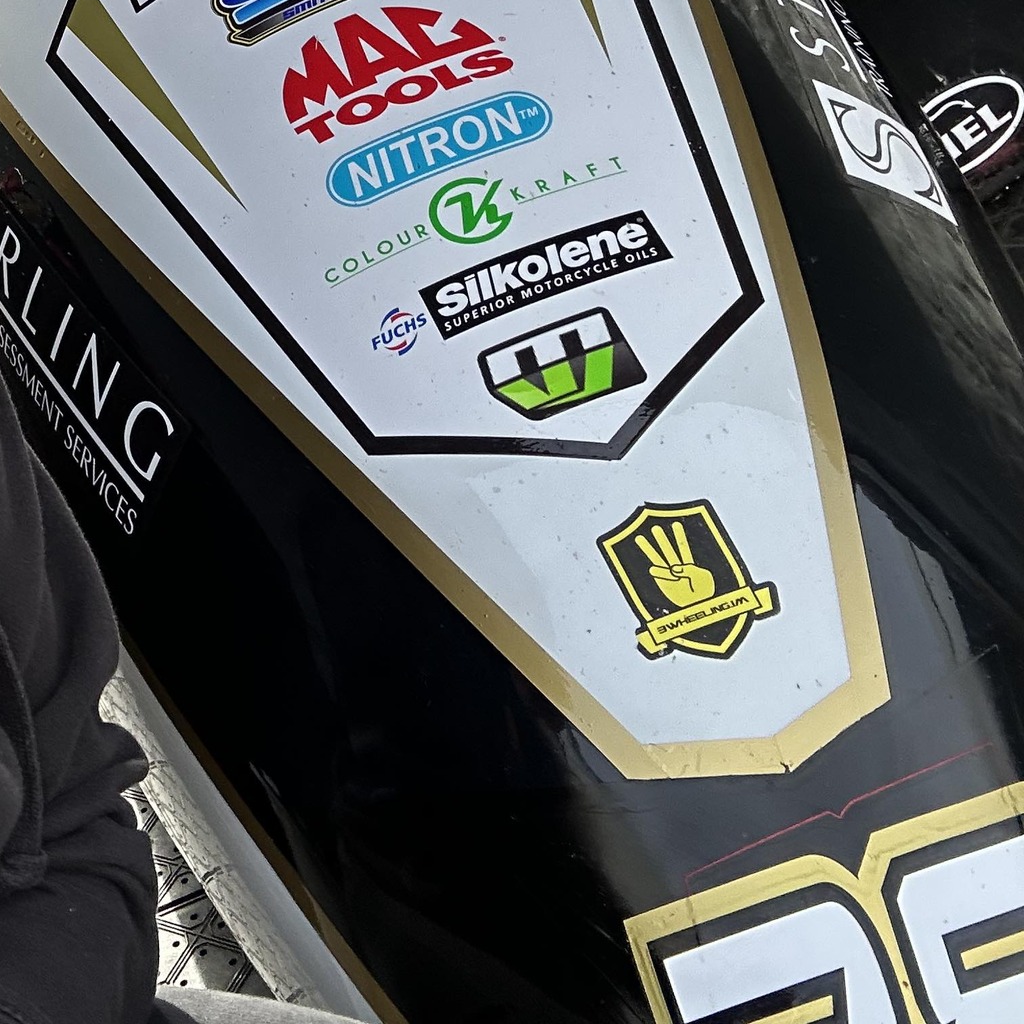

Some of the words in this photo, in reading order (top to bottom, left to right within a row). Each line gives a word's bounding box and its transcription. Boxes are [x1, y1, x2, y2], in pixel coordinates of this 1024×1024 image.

[282, 6, 496, 125] MAC
[293, 49, 514, 144] TOOLS
[323, 223, 430, 284] COLOUR
[509, 156, 626, 201] KRAFT
[371, 311, 428, 352] FUCHS
[443, 293, 516, 333] SUPERIOR
[520, 258, 620, 301] MOTORCYCLE
[624, 246, 660, 265] OILS
[64, 424, 138, 536] SERVICES
